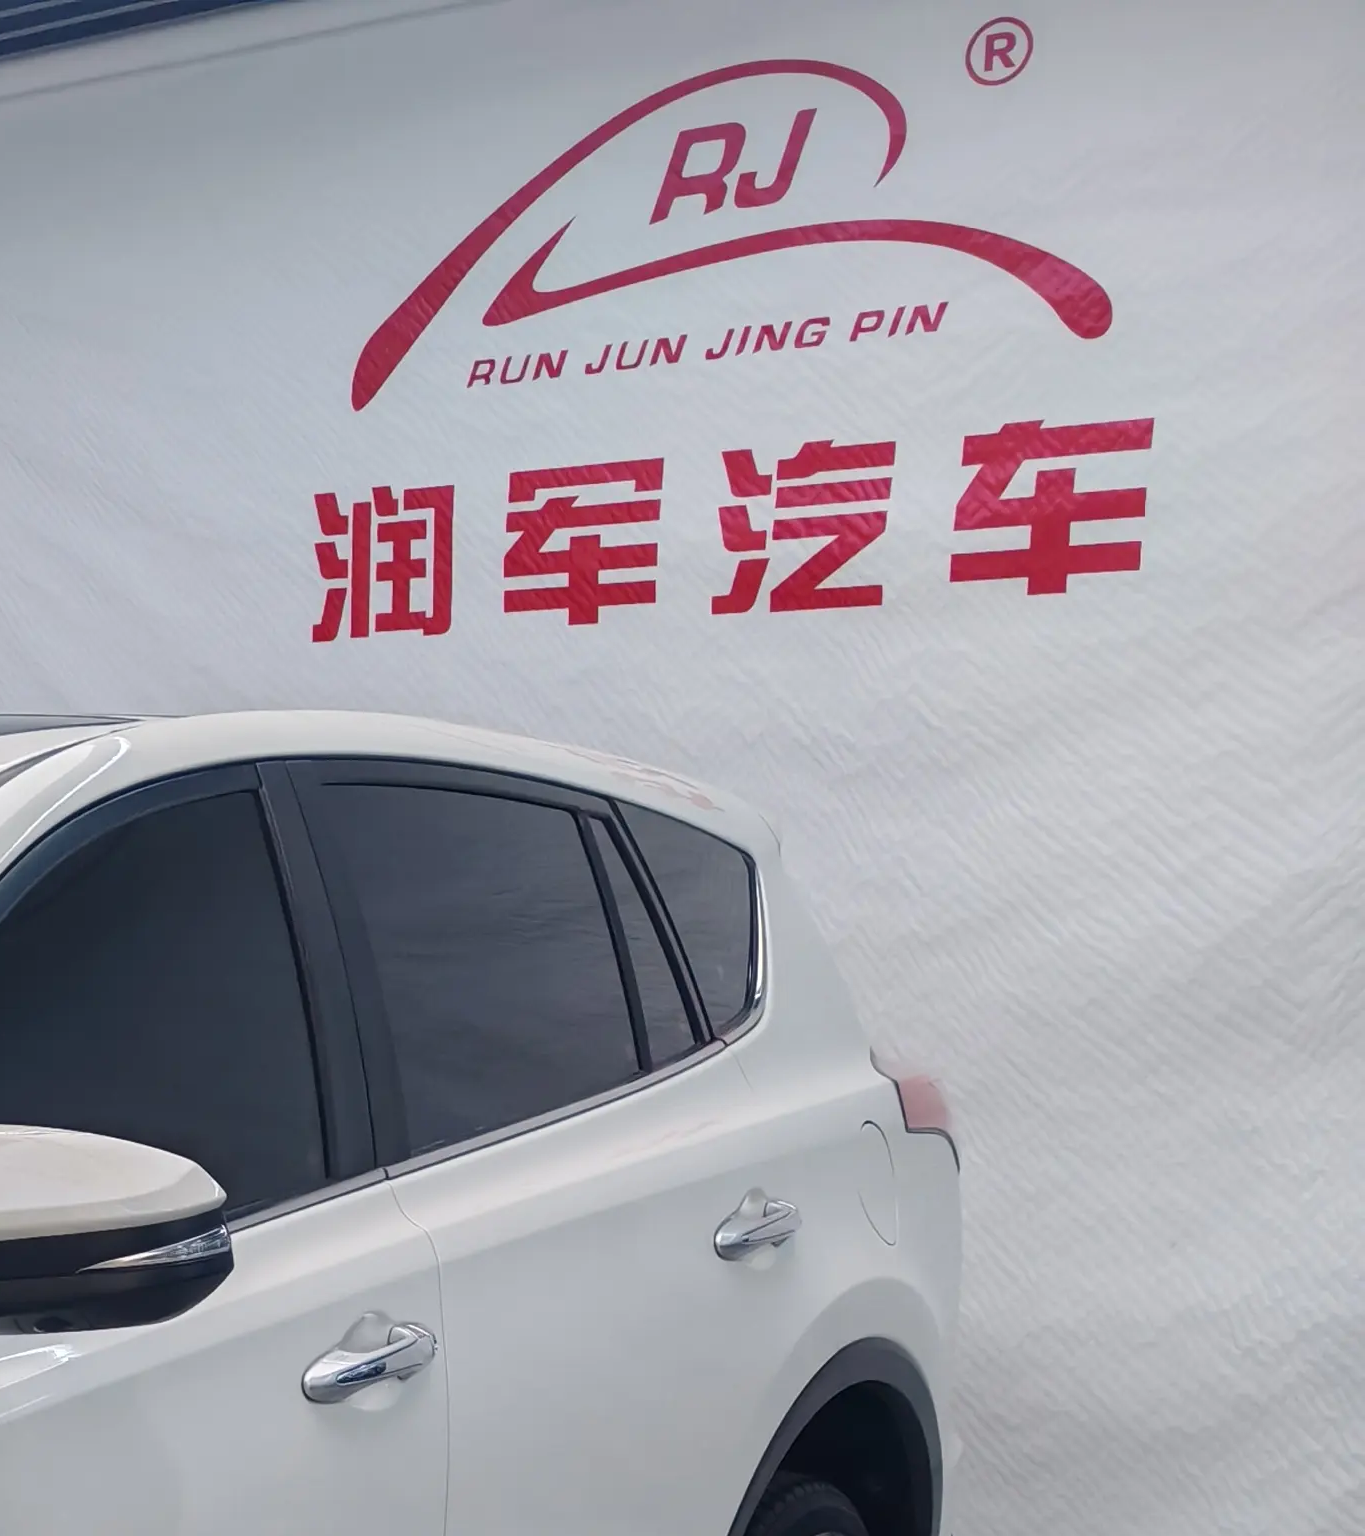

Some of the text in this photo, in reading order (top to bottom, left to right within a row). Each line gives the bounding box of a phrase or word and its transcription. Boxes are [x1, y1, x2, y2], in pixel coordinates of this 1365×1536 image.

[649, 107, 817, 224] RJ
[466, 301, 949, 388] RUN JUN JING PIN
[310, 416, 1155, 643] 润军汽车
